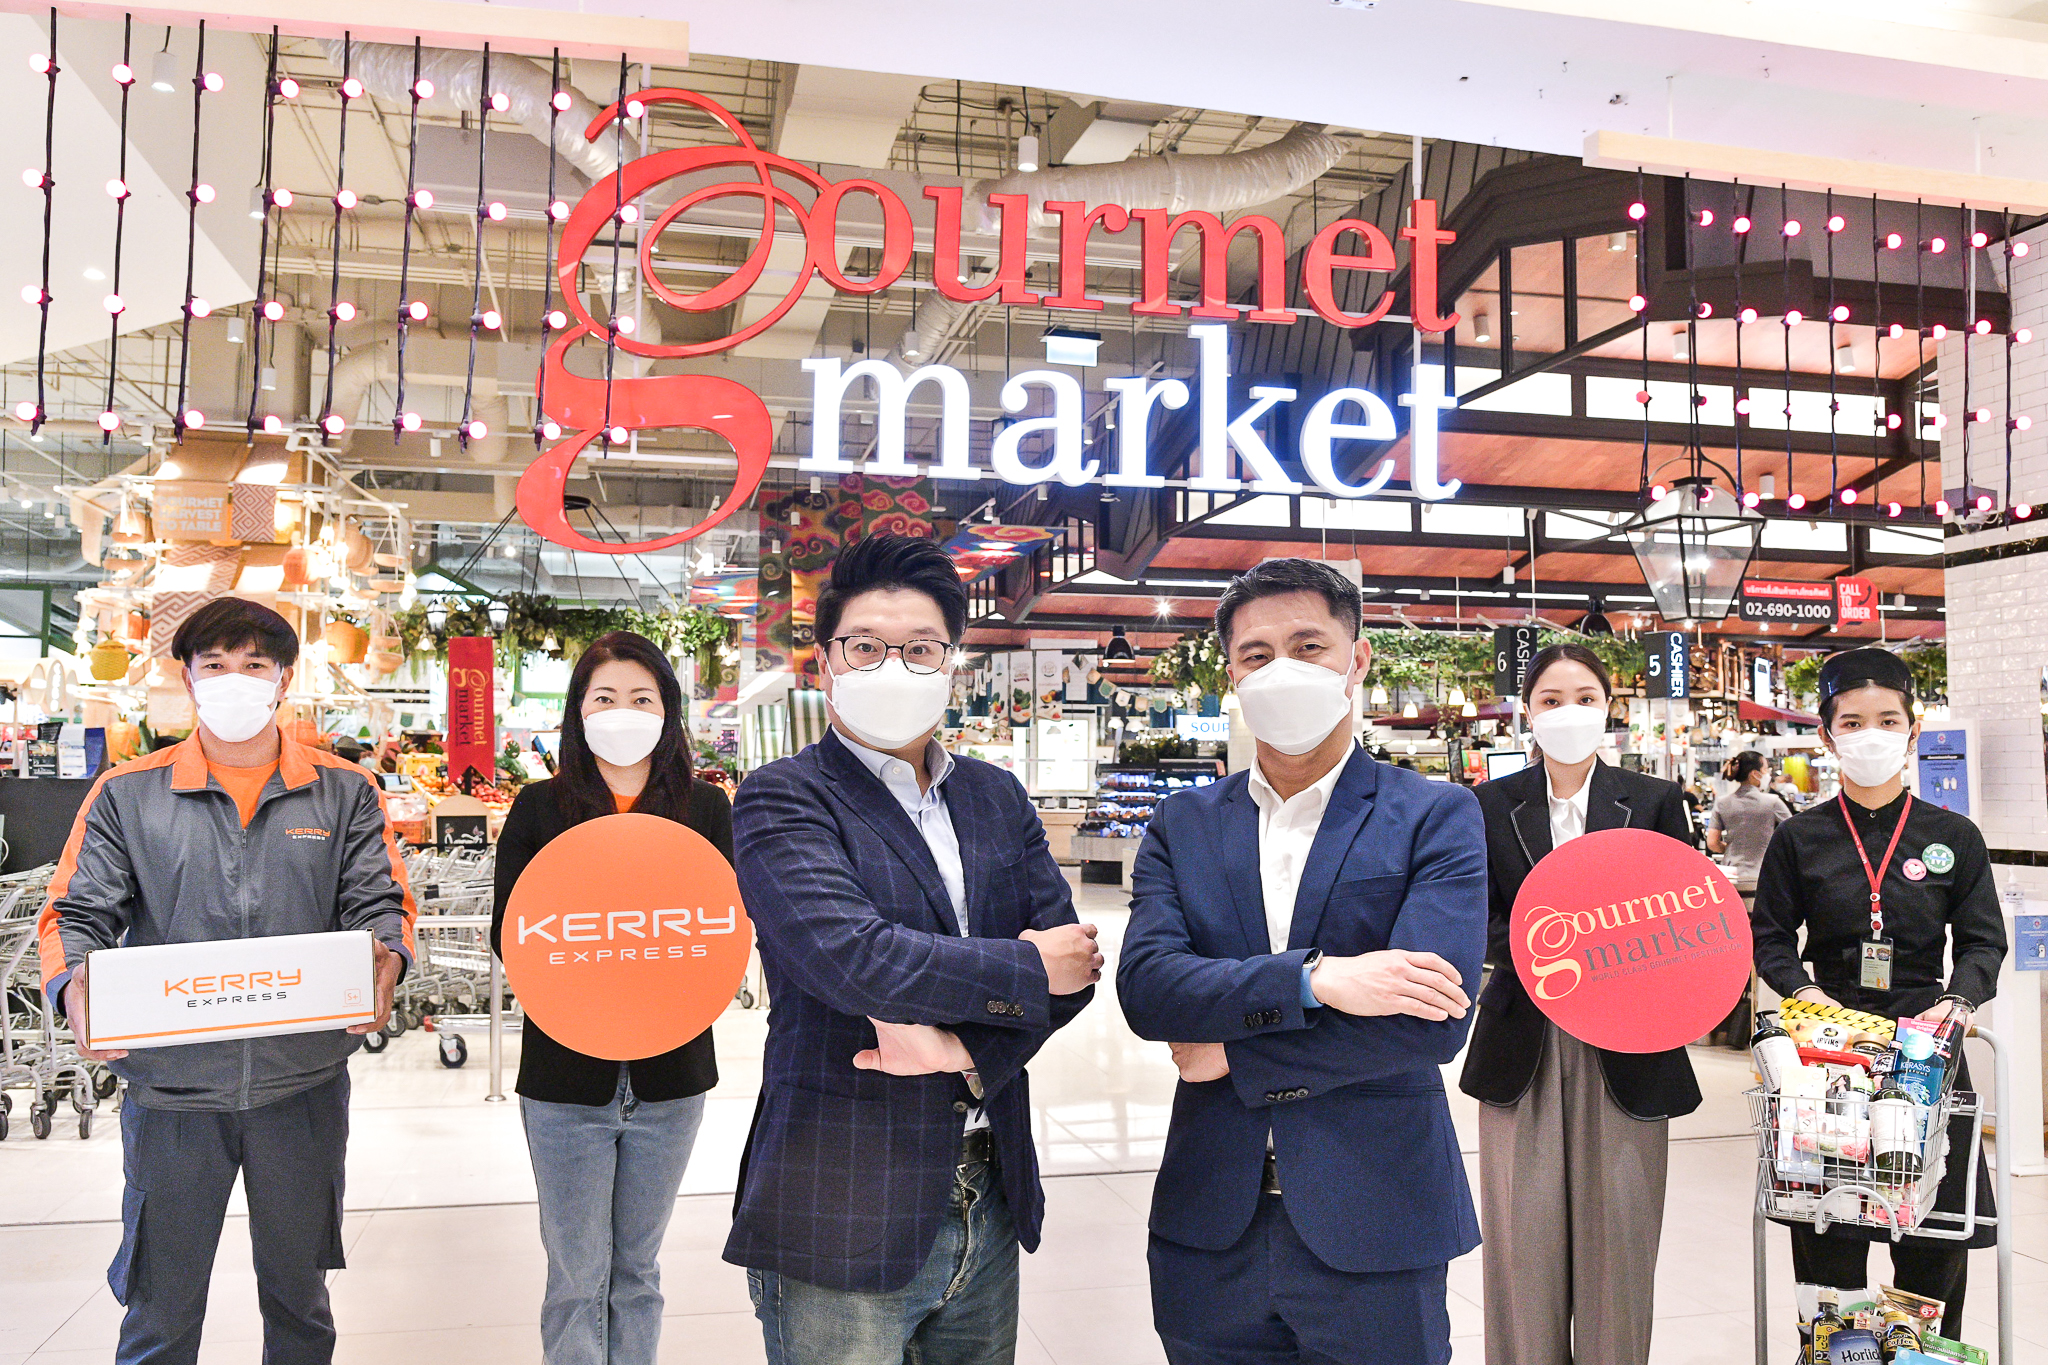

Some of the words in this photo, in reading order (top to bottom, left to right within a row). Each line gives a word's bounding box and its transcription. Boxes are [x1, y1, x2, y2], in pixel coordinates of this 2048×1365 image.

[515, 87, 1462, 555] gourmet
[799, 324, 1464, 501] market
[157, 496, 225, 508] GOURMET
[160, 508, 222, 520] HARVEST
[160, 520, 177, 531] TO
[180, 520, 221, 532] TABLE
[1839, 583, 1862, 597] CALL
[1745, 601, 1832, 619] 02-690-1000
[1840, 595, 1853, 608] TO
[1840, 606, 1871, 620] ORDER
[1497, 651, 1507, 672] 6
[1649, 654, 1661, 677] 5
[1670, 632, 1684, 698] CASHIER
[452, 667, 490, 746] gourmet
[458, 688, 474, 746] market
[285, 827, 331, 837] KERRY
[518, 905, 736, 945] KERRY
[1524, 875, 1725, 1001] gourmet
[1583, 911, 1738, 971] market
[549, 944, 707, 965] EXPRESS
[1590, 971, 1620, 983] WORLD
[1621, 964, 1648, 976] CLASS
[1649, 954, 1688, 970] GOURMET
[1690, 943, 1742, 961] DESTINATION
[164, 968, 302, 997] KERRY
[187, 991, 288, 1008] EXPRESS
[1816, 1037, 1839, 1048] IRVINS
[1900, 1061, 1931, 1073] KERASYS
[1920, 1307, 1937, 1317] 67
[1886, 1338, 1914, 1348] Coffee
